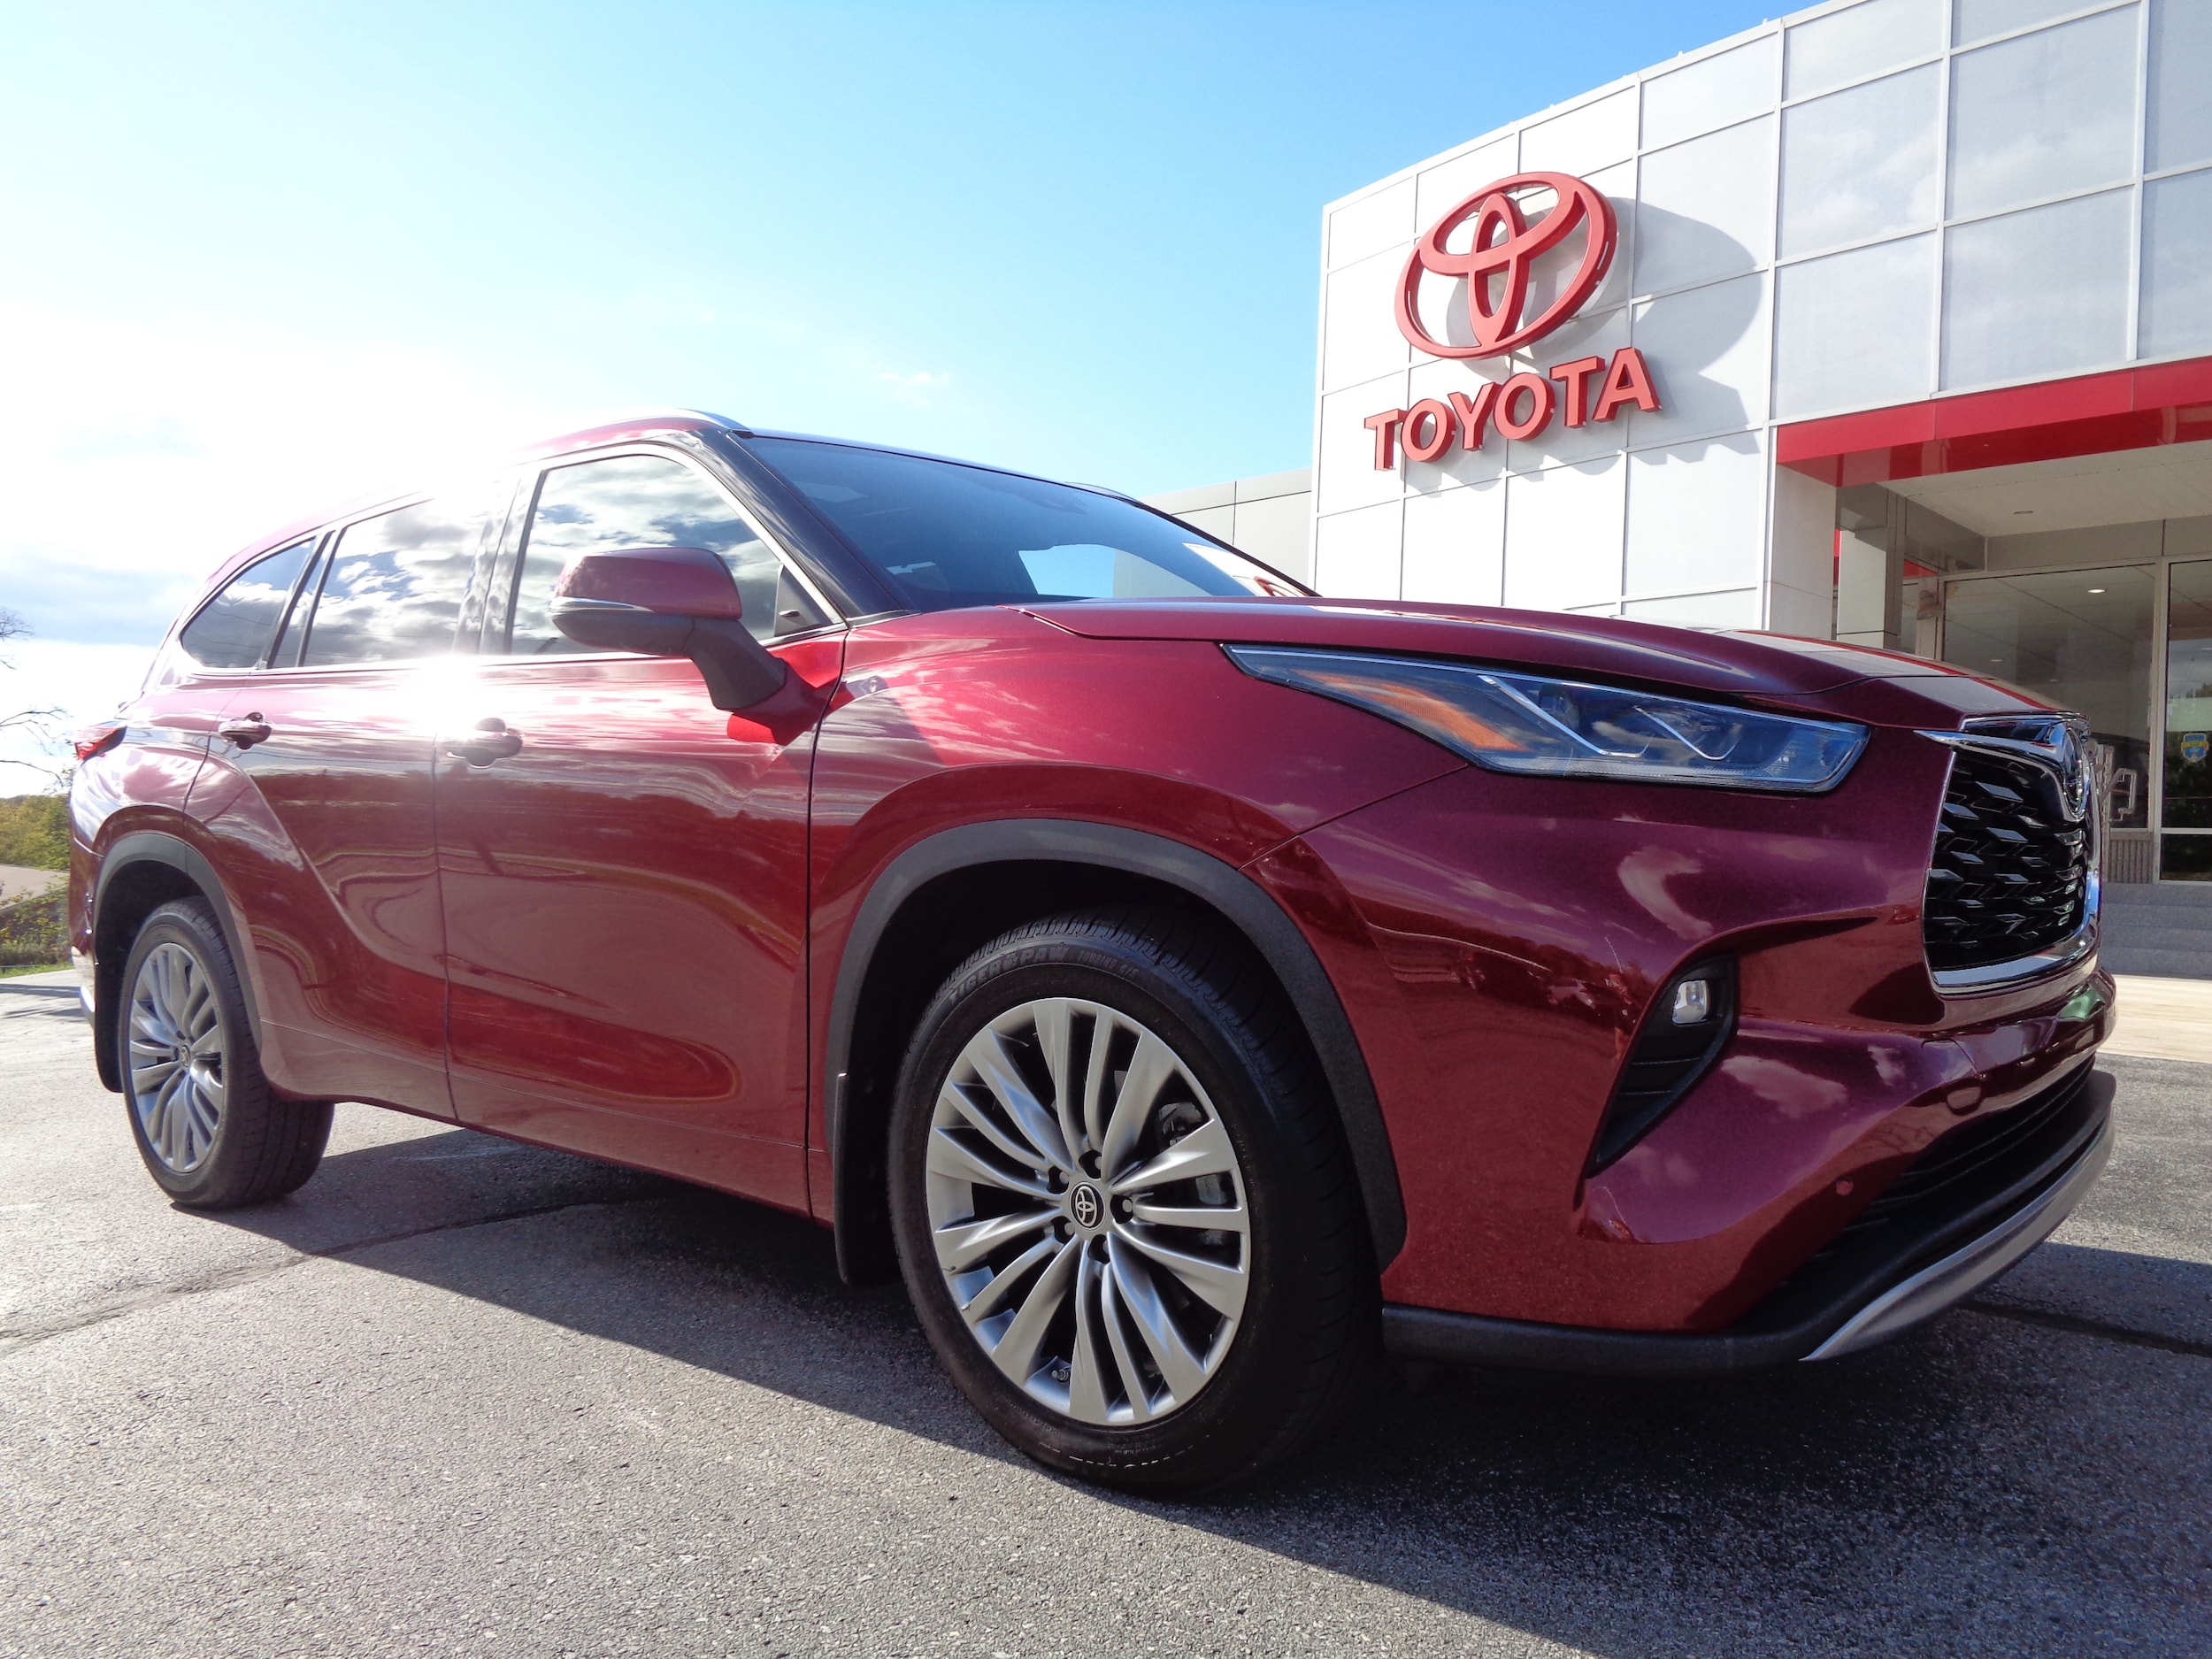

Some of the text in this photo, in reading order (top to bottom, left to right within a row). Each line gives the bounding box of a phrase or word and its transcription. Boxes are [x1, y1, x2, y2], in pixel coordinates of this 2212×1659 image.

[1364, 346, 1662, 472] TOYOTA
[949, 959, 1002, 1004] TIGER
[1020, 947, 1069, 965] PAW
